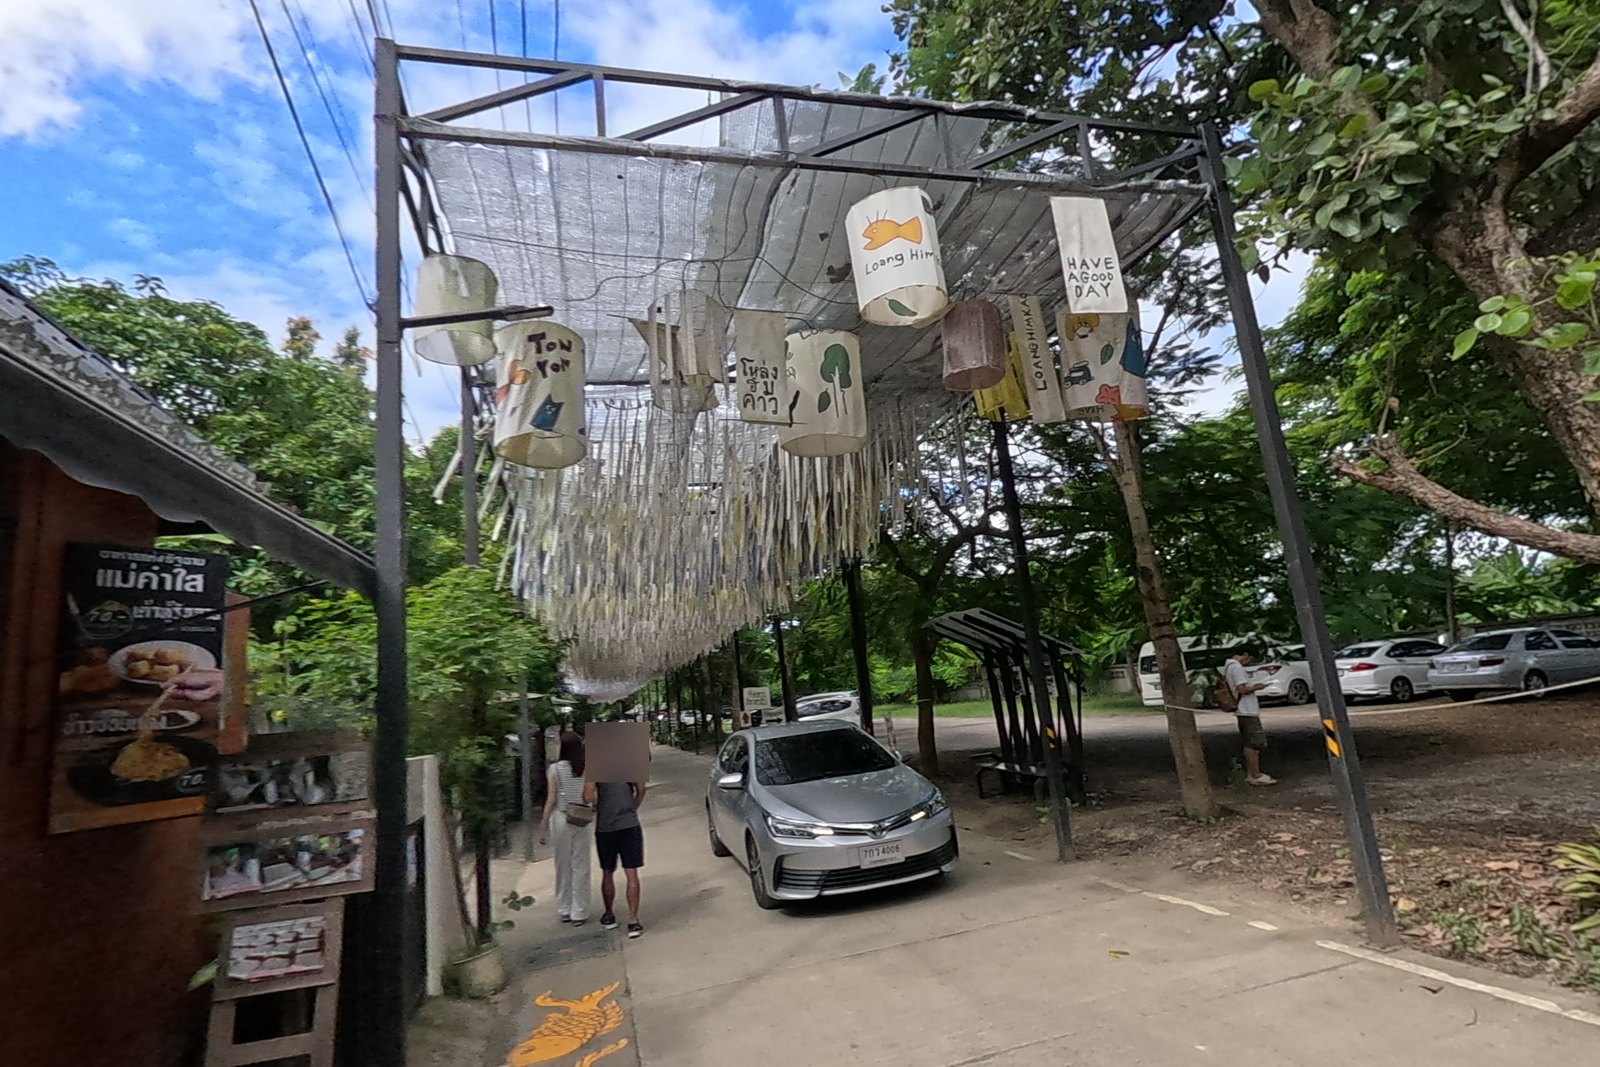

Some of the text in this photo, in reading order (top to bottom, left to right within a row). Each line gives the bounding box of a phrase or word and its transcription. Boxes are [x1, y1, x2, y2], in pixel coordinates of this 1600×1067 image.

[865, 253, 905, 276] Loang
[1066, 256, 1115, 270] HAVE
[1075, 282, 1111, 298] DAY
[740, 357, 779, 380] โหล่ง
[742, 393, 779, 415] คาว
[96, 562, 205, 593] แม่คำใส
